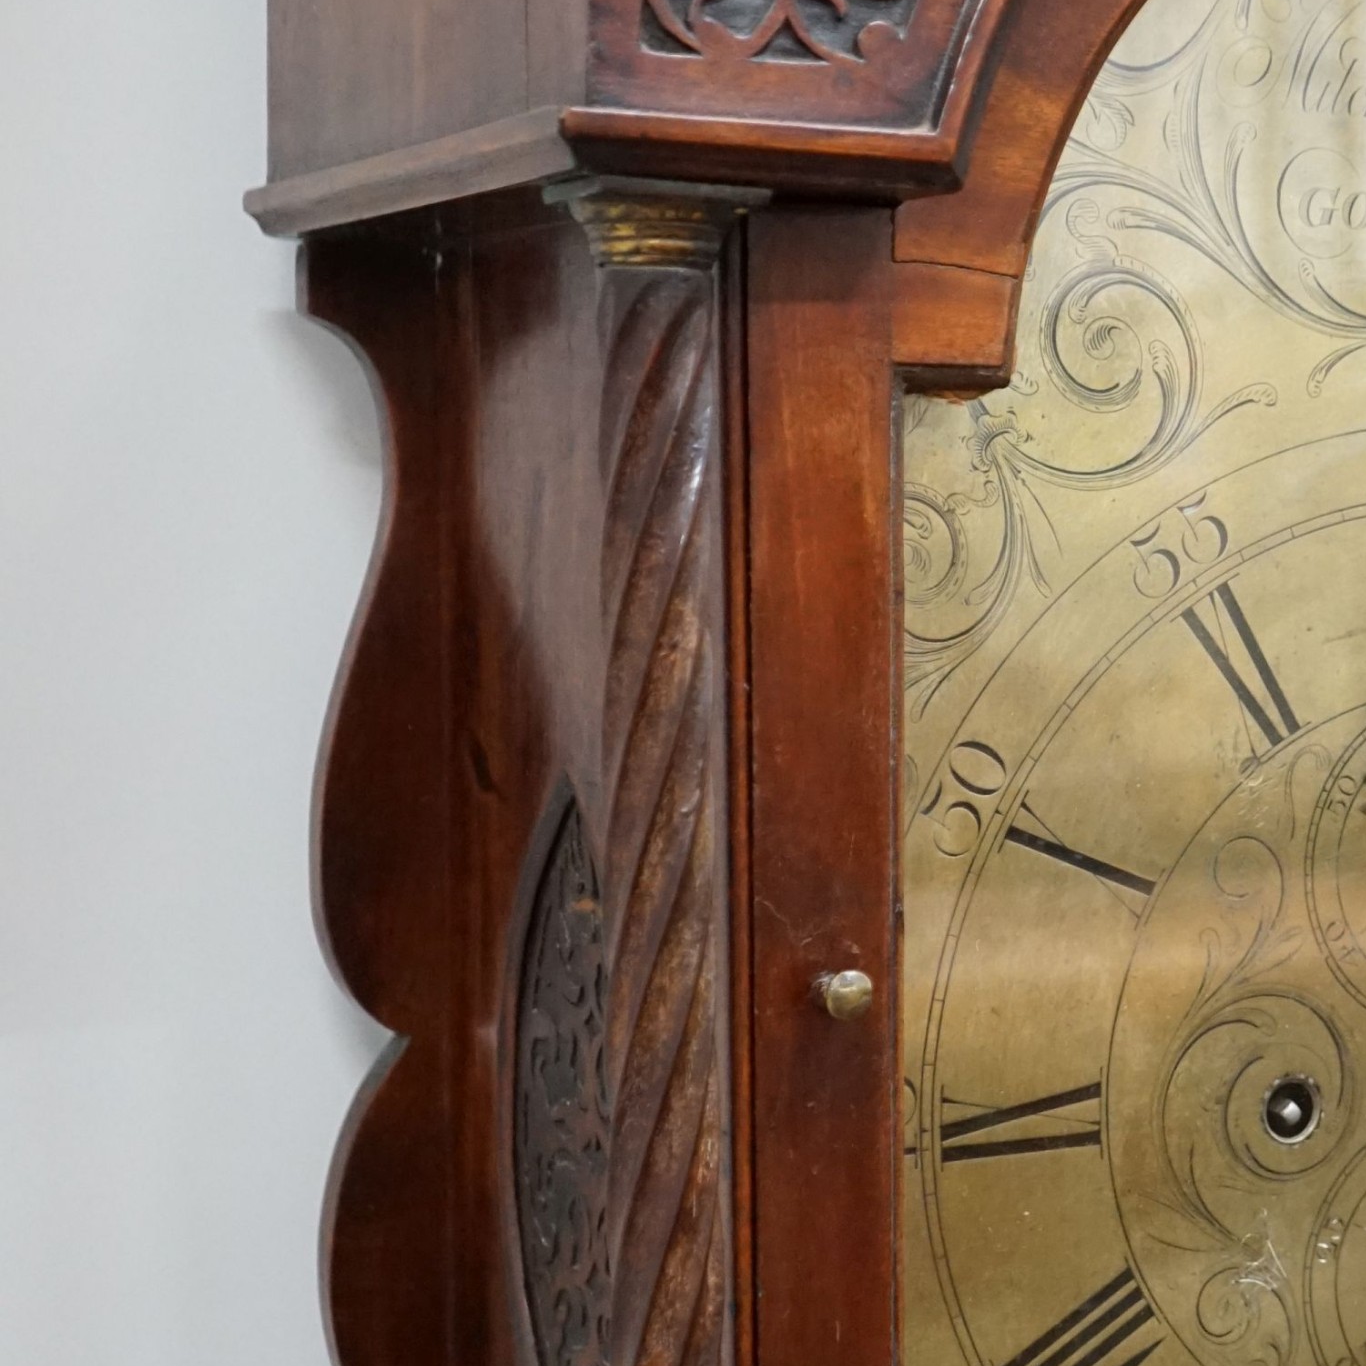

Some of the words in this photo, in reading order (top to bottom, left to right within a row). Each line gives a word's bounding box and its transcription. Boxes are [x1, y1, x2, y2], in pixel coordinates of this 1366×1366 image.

[1129, 490, 1230, 599] 55
[1169, 572, 1312, 761] XI
[919, 739, 1008, 859] 50
[1326, 773, 1357, 823] 50
[996, 788, 1168, 931] X
[939, 1067, 1104, 1173] IX
